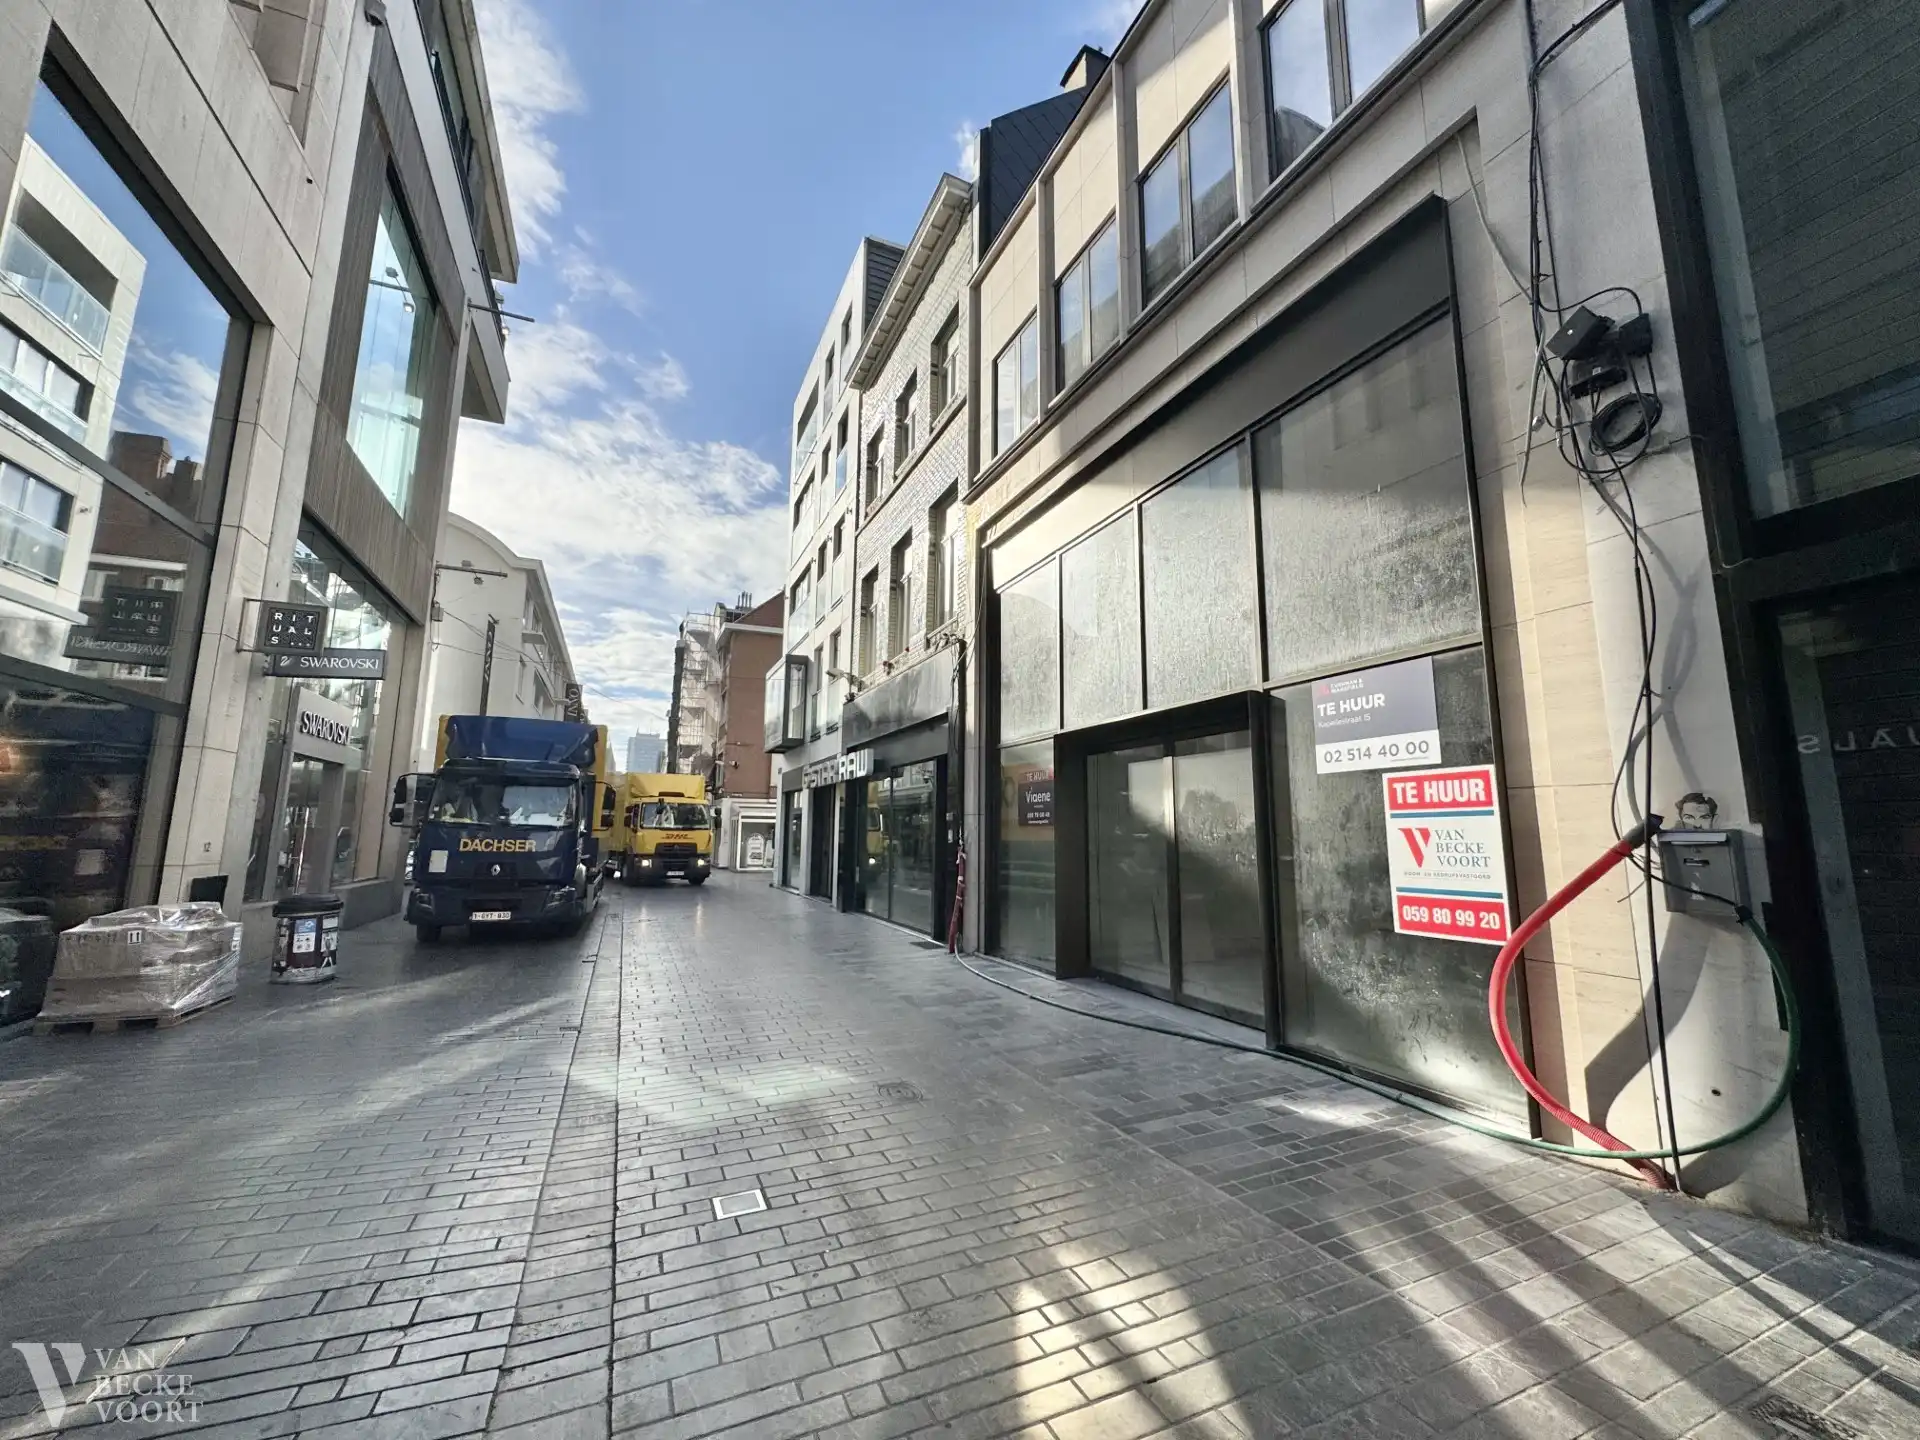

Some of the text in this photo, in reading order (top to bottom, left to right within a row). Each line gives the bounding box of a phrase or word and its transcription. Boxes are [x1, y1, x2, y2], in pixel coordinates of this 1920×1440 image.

[300, 656, 379, 669] SWAROVSKI
[1317, 693, 1386, 717] TE HUUR
[300, 711, 351, 746] SWAROVSKI
[1324, 740, 1430, 763] 02 514 40 00
[839, 749, 874, 780] RAW
[1025, 788, 1051, 803] Viaene
[1393, 778, 1486, 804] TE HUUR
[1435, 829, 1464, 841] VAN
[459, 838, 536, 852] DACHSER
[1436, 842, 1484, 854] BECKE
[1437, 855, 1491, 868] VOORT
[1402, 905, 1501, 930] 059 80 99 20
